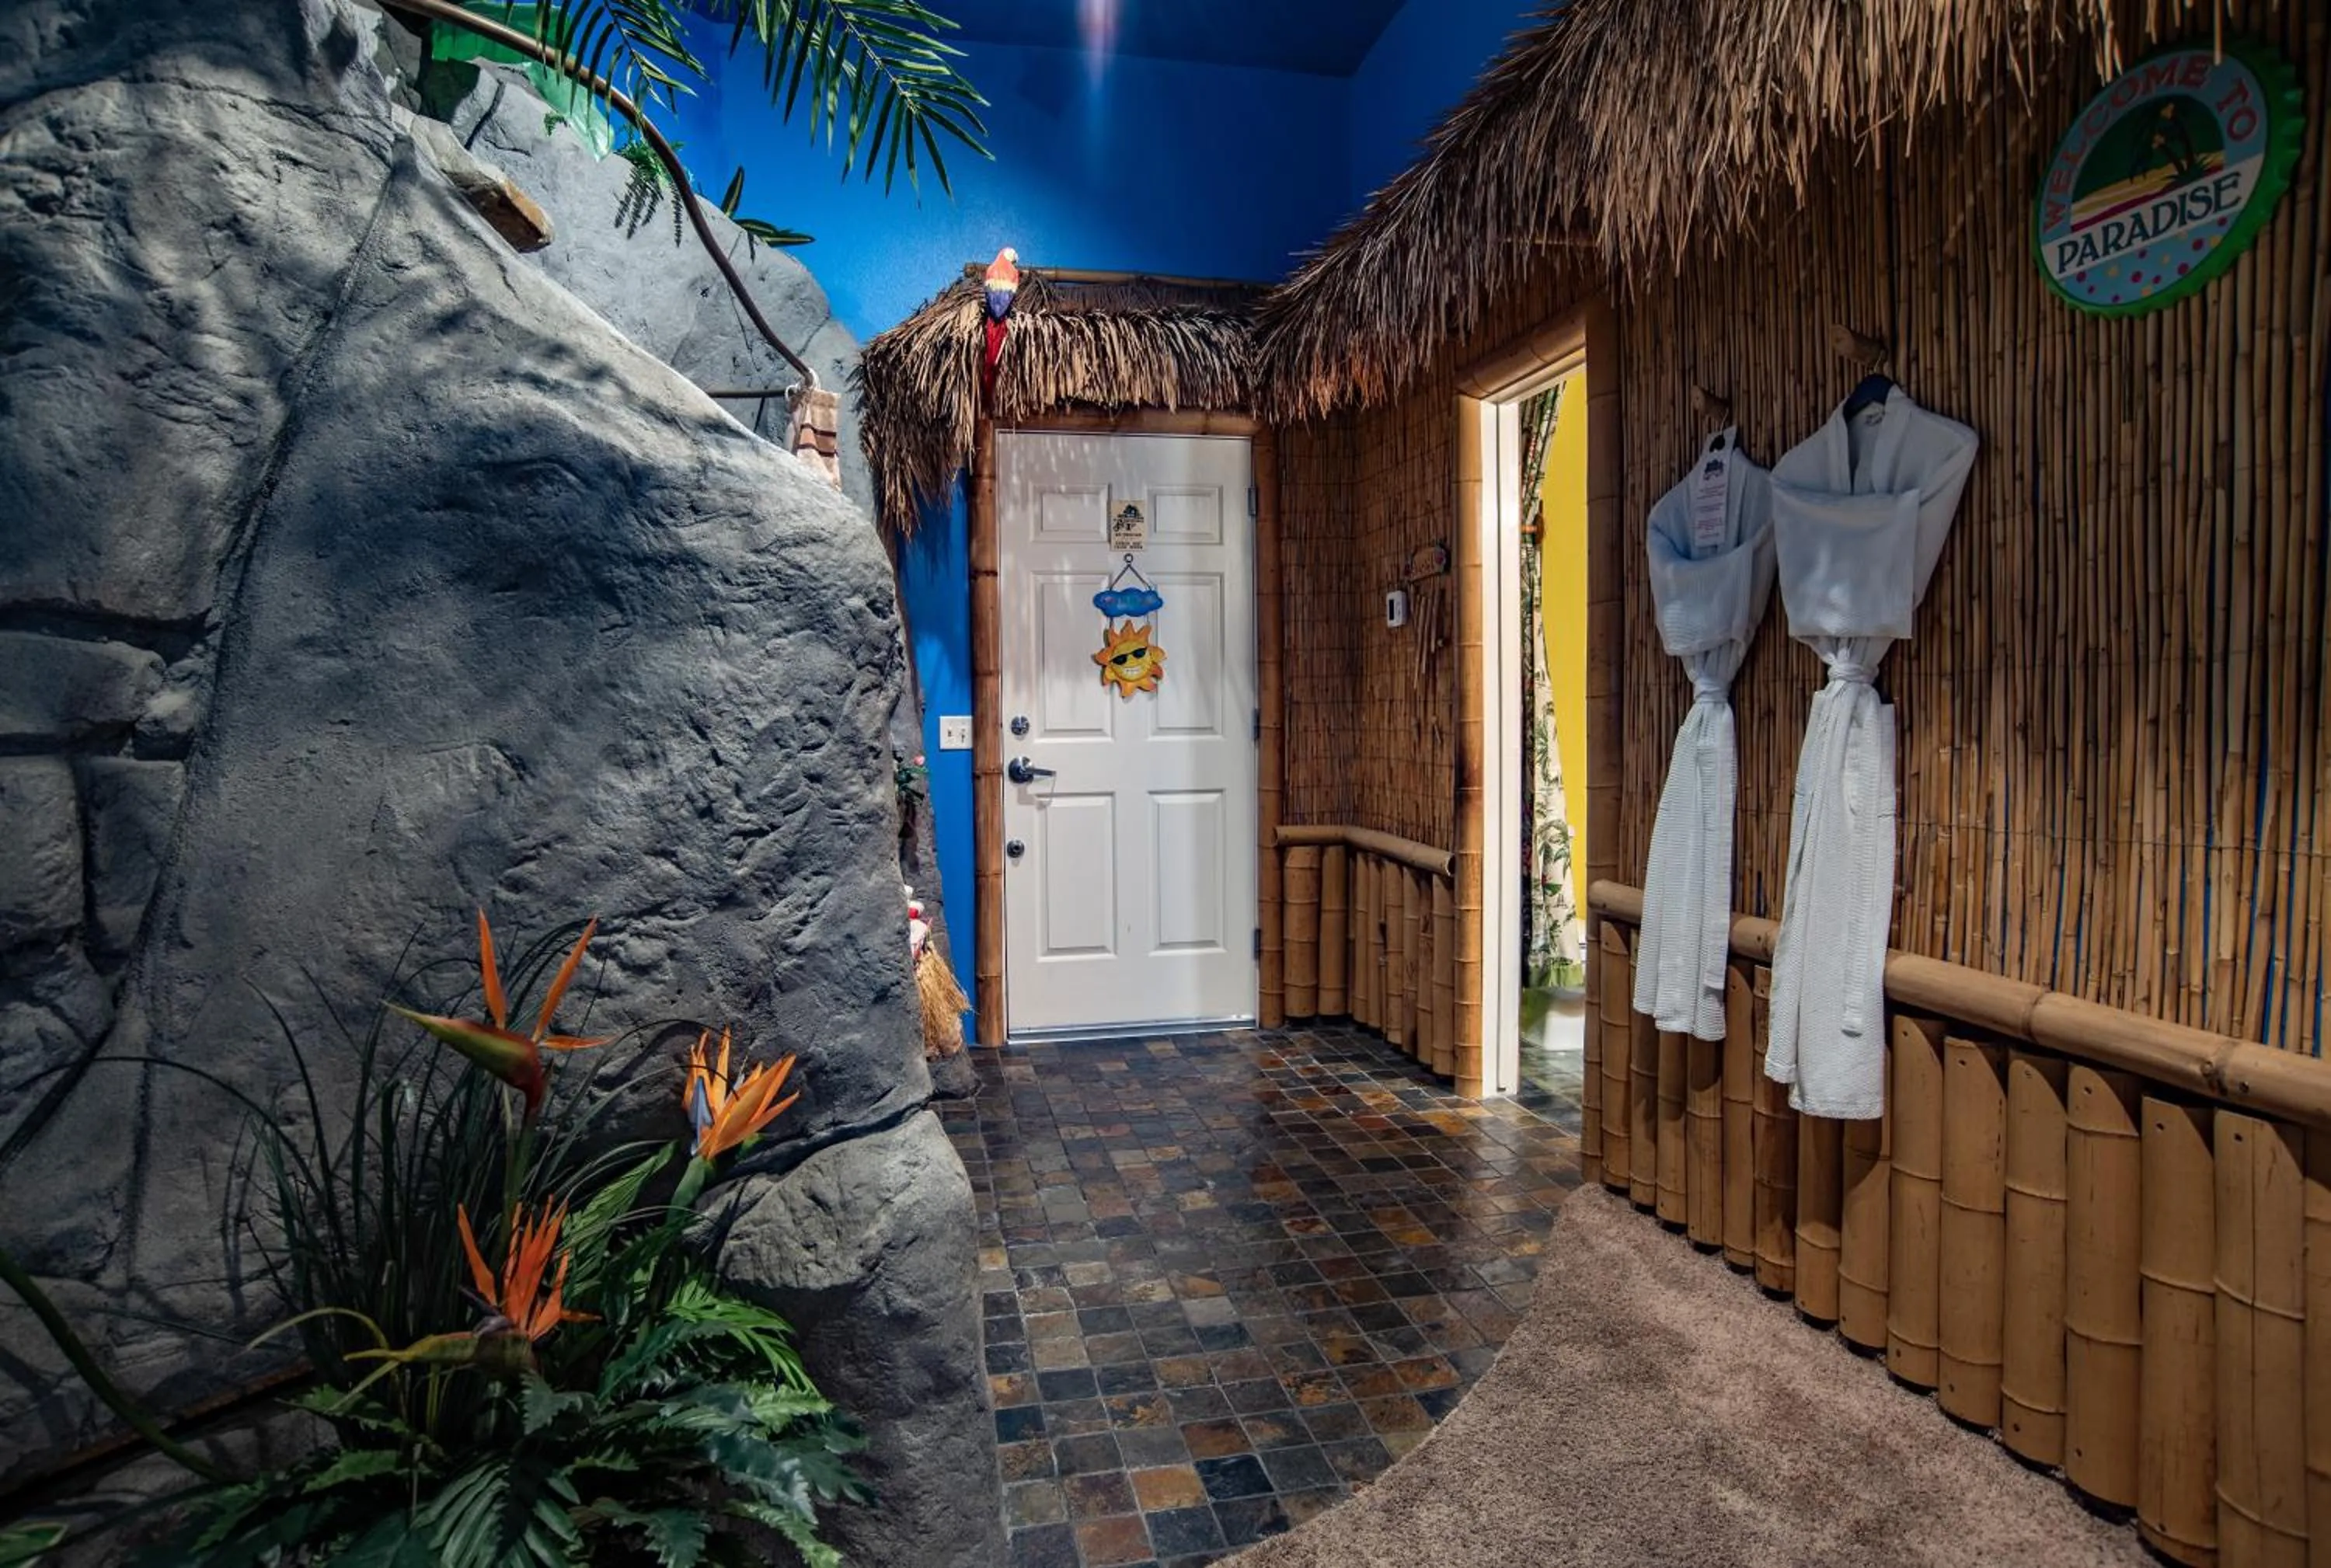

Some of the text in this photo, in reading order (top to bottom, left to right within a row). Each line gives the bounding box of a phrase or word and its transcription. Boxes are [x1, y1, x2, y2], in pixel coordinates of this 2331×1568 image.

[2043, 55, 2257, 232] WELCOME TO
[2057, 172, 2241, 274] PARADISE
